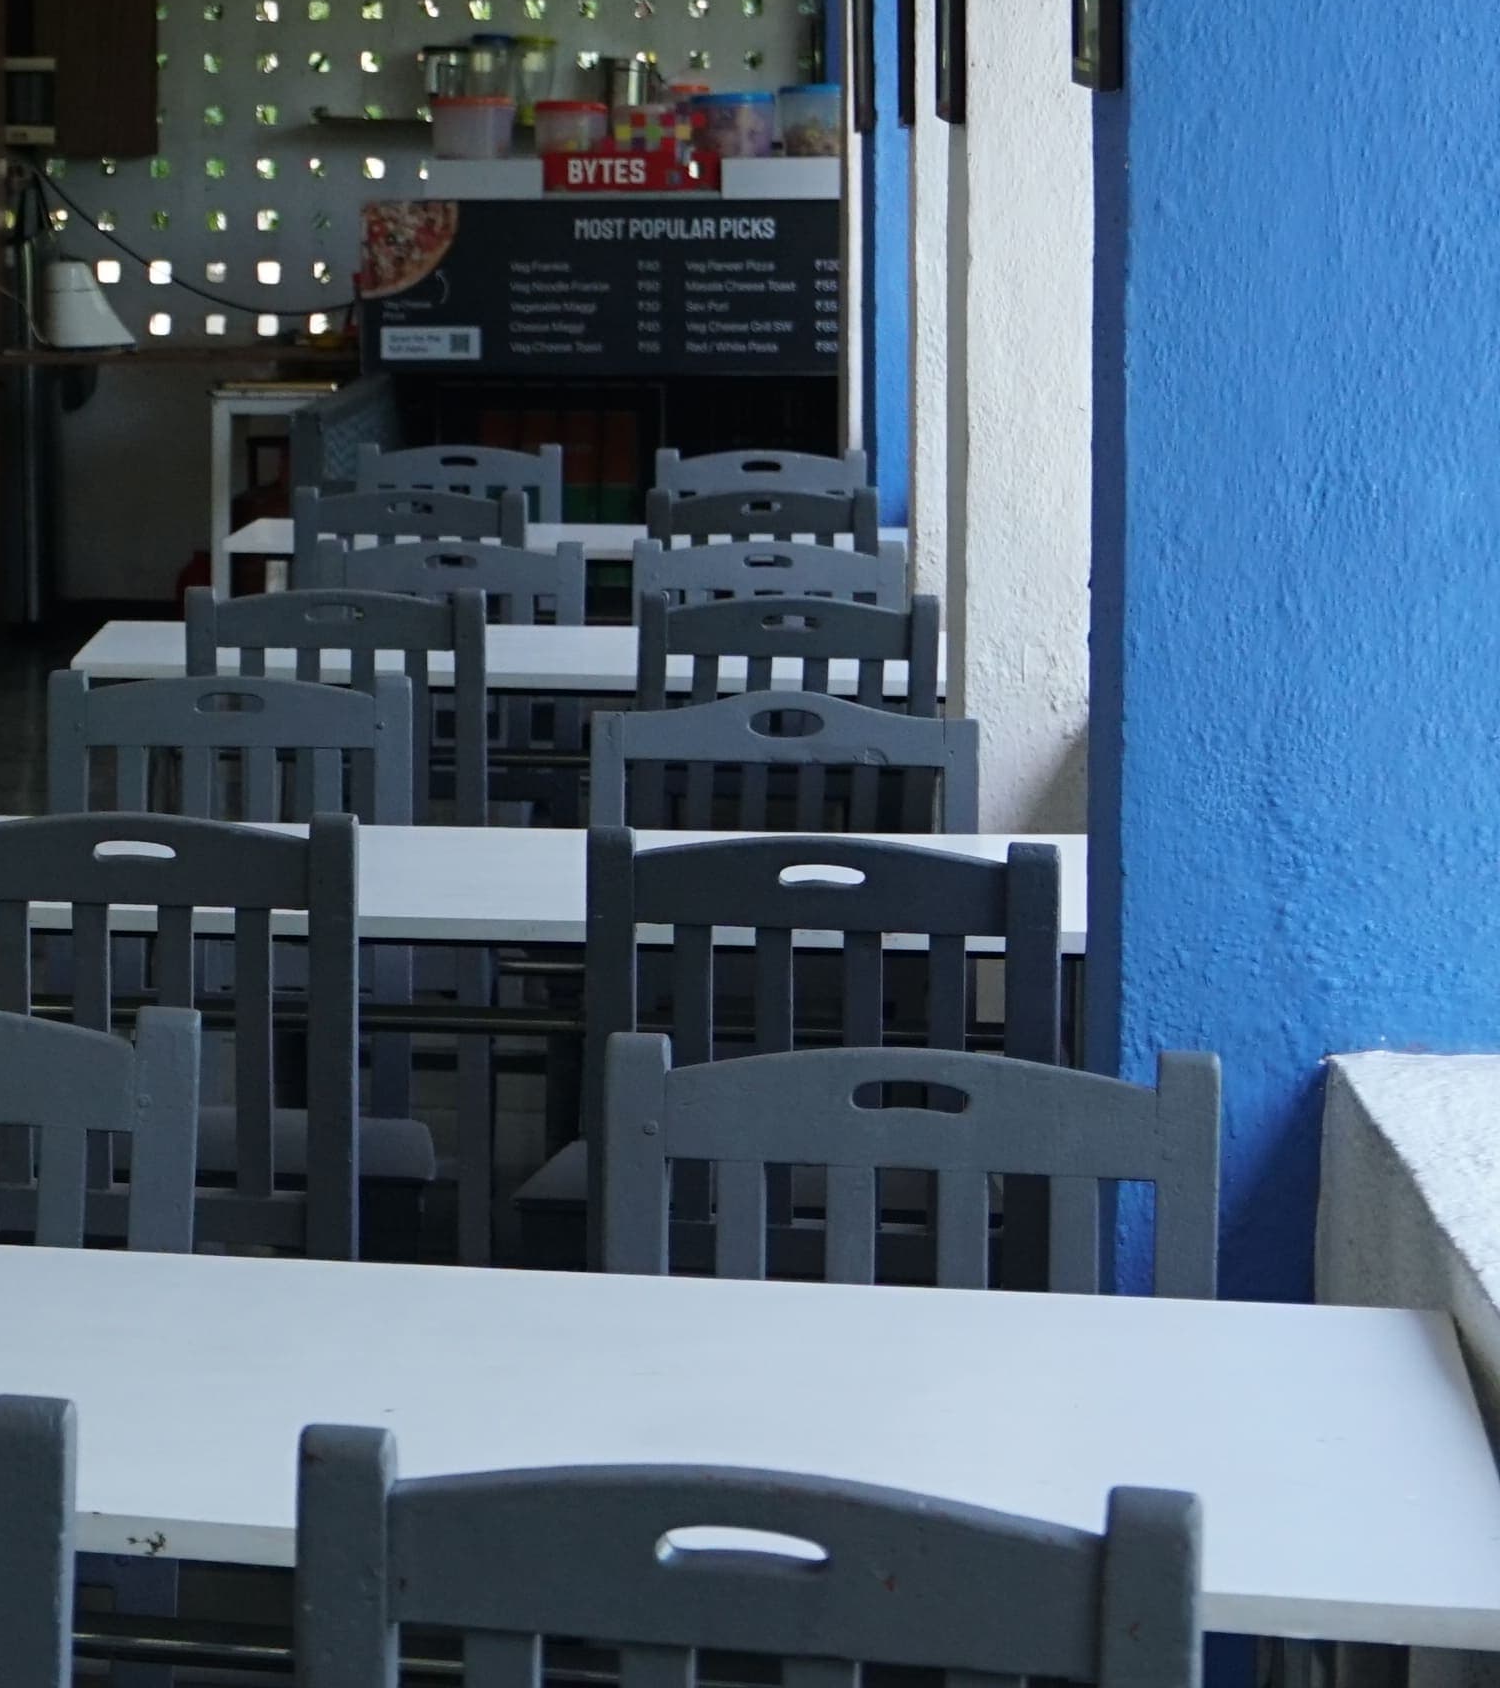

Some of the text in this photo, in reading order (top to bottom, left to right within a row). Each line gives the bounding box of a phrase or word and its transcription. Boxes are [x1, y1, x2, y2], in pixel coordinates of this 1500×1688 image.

[567, 158, 647, 184] BYTES
[574, 217, 776, 240] MOST POPULAR PICKS
